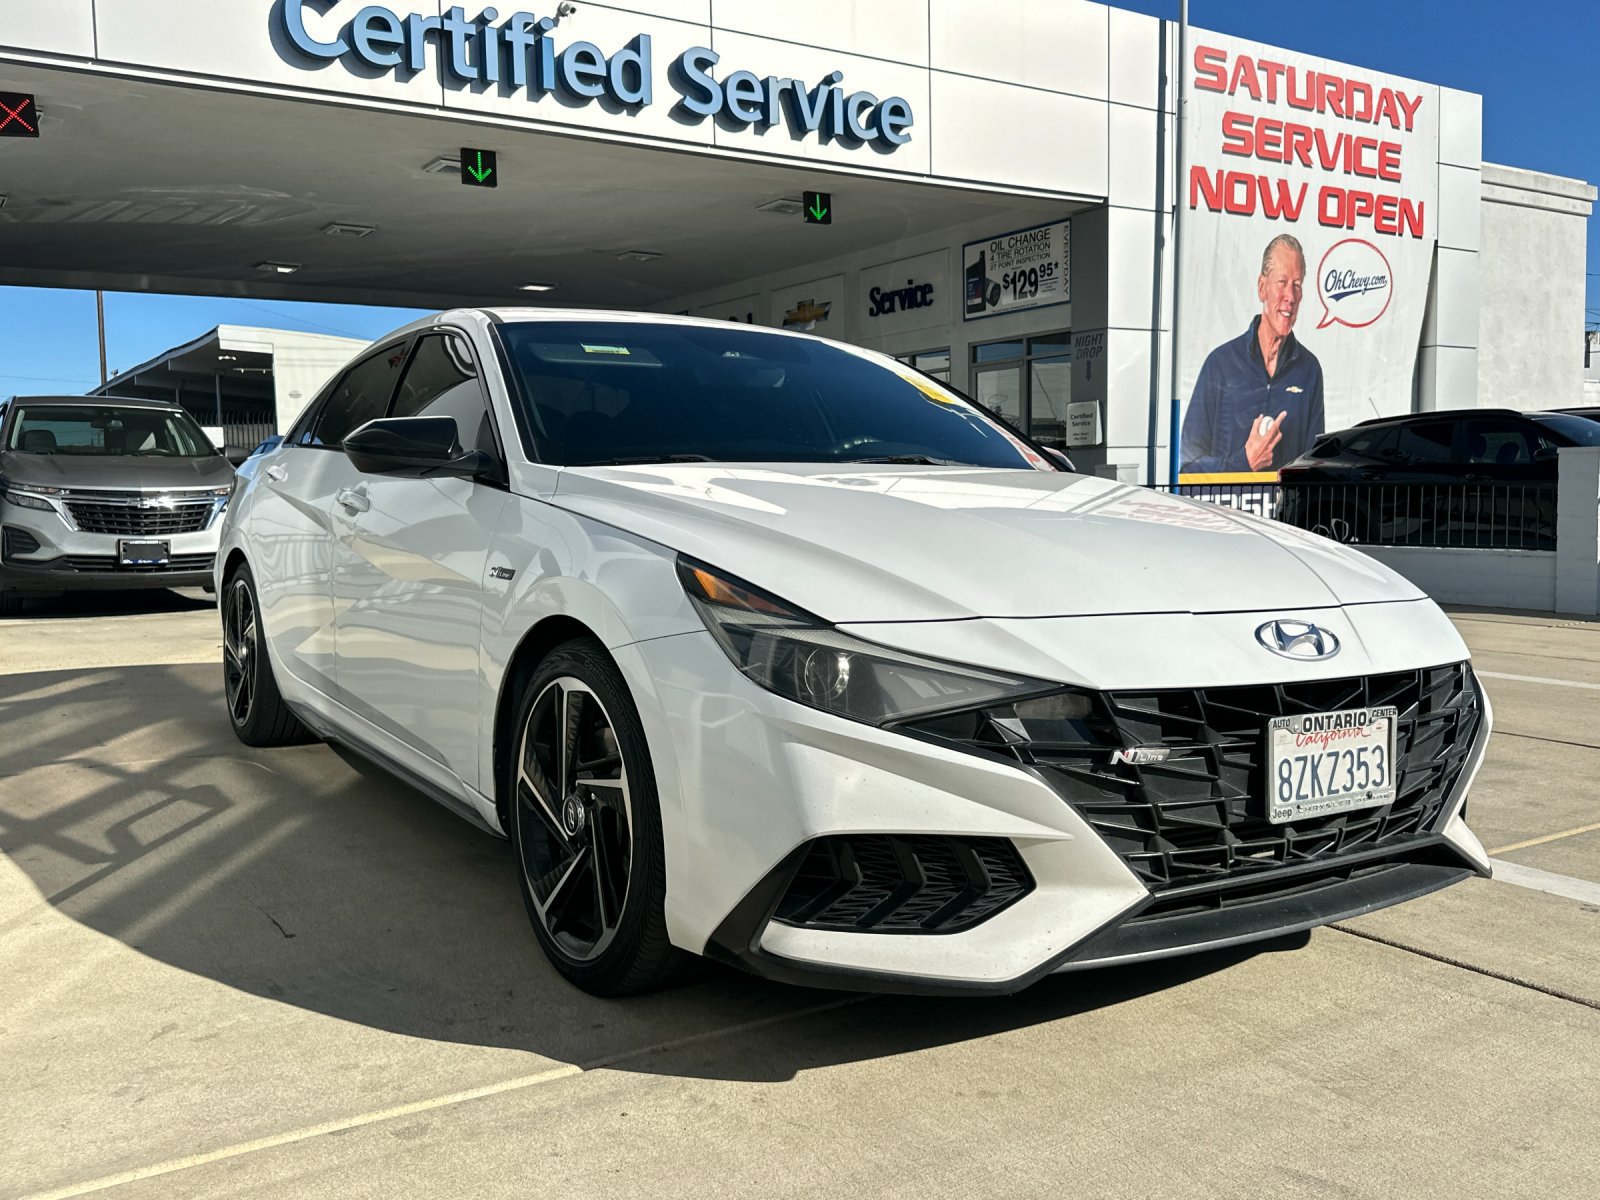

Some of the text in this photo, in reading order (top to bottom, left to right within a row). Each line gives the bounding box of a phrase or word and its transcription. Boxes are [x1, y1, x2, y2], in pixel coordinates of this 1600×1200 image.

[283, 0, 914, 145] Certified Service
[1194, 45, 1423, 131] SATURDAY
[1222, 111, 1402, 182] SERVICE
[1190, 165, 1424, 239] NOW OPEN
[990, 228, 1051, 253] OIL CHANGE
[997, 251, 1012, 260] TIRE
[1014, 242, 1051, 257] ROTATION
[998, 260, 1014, 269] POINT
[1015, 252, 1051, 265] INSPECTION
[1325, 269, 1387, 295] OhChevy.com
[869, 279, 934, 317] Service
[1074, 333, 1104, 348] NIGHT
[1075, 346, 1103, 359] DROP
[1272, 707, 1397, 733] AUTO ONTARIO CENTER
[1296, 727, 1371, 751] California
[1279, 745, 1385, 803] 8ZKZ353
[1272, 808, 1293, 819] Jeep
[1297, 800, 1352, 813] CHRYSLER
